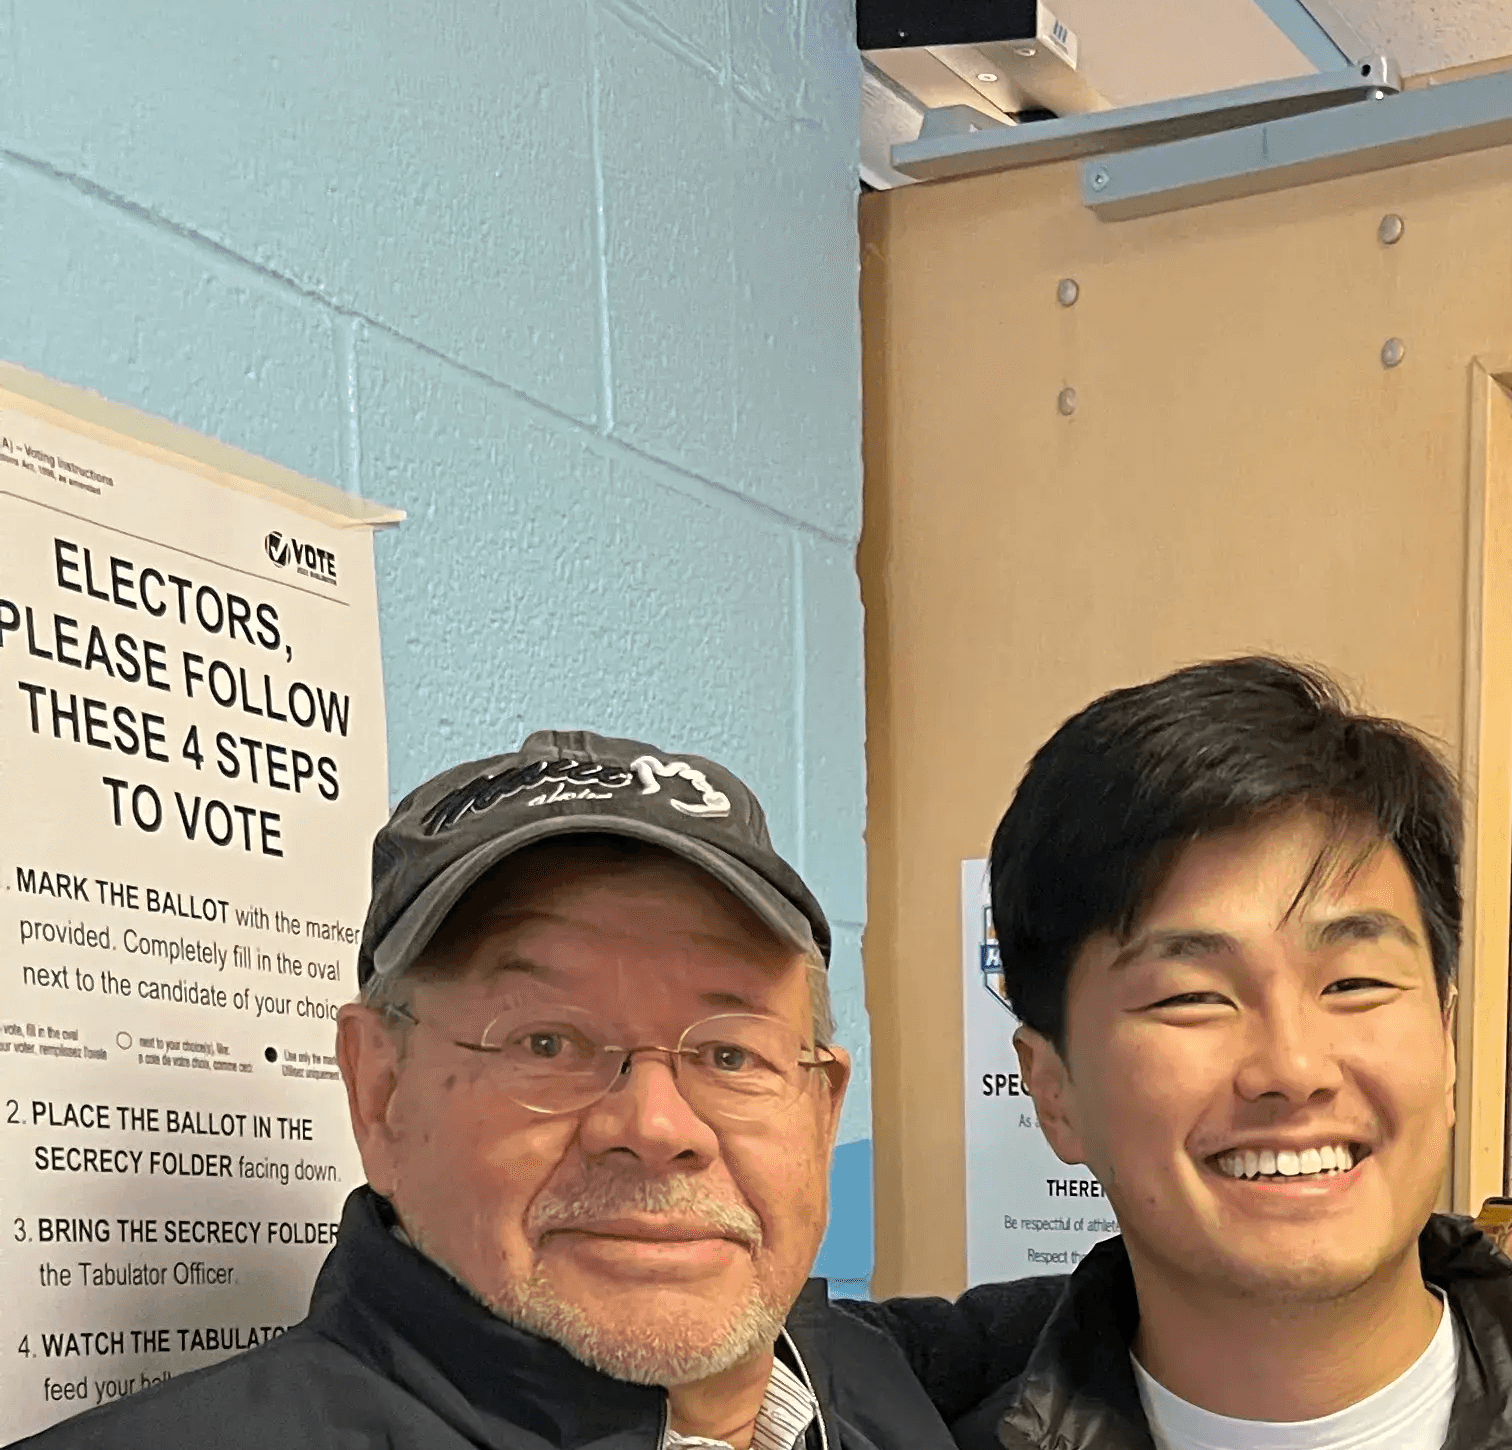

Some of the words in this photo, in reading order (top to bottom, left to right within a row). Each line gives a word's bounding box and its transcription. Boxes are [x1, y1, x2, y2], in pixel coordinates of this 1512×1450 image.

[24, 443, 55, 468] Voting
[57, 456, 113, 486] Instructions
[291, 538, 337, 578] VOTE
[54, 537, 292, 662] ELECTORS,
[0, 598, 171, 692] PLEASE
[183, 651, 350, 737] FOLLOW
[18, 681, 169, 763] THESE
[182, 724, 204, 770] 4
[215, 731, 340, 801] STEPS
[103, 776, 161, 832] TO
[174, 791, 283, 857] VOTE
[16, 867, 89, 902] MARK
[95, 879, 139, 910] THE
[147, 889, 229, 923] BALLOT
[235, 907, 269, 931] with
[275, 911, 300, 935] the
[306, 920, 360, 945] marker
[20, 919, 117, 952] provided.
[124, 928, 227, 972] Completely
[233, 944, 252, 969] fill
[256, 949, 271, 972] in
[277, 952, 302, 977] the
[307, 960, 340, 981] oval
[23, 964, 69, 989] next
[76, 967, 94, 992] to
[101, 970, 131, 996] the
[138, 976, 227, 1009] candidate
[233, 987, 251, 1010] of
[254, 994, 291, 1018] your
[297, 995, 339, 1022] choic
[32, 1100, 111, 1129] PLACE
[117, 1106, 160, 1132] THE
[166, 1109, 247, 1137] BALLOT
[253, 1115, 271, 1139] IN
[277, 1117, 313, 1141] THE
[35, 1146, 143, 1174] SECRECY
[150, 1151, 233, 1178] FOLDER
[239, 1155, 289, 1185] facing
[295, 1158, 342, 1182] down.
[14, 1217, 34, 1242] 3.
[38, 1218, 110, 1243] BRING
[117, 1219, 157, 1243] THE
[164, 1220, 262, 1244] SECRECY
[268, 1222, 340, 1244] FOLDER
[1004, 1215, 1018, 1229] Be
[40, 1263, 71, 1287] the
[78, 1262, 167, 1286] Tabulator
[1028, 1248, 1069, 1265] Respect
[42, 1331, 124, 1358] WATCH
[131, 1329, 171, 1353] THE
[44, 1376, 88, 1401] feed
[95, 1377, 135, 1405] your
